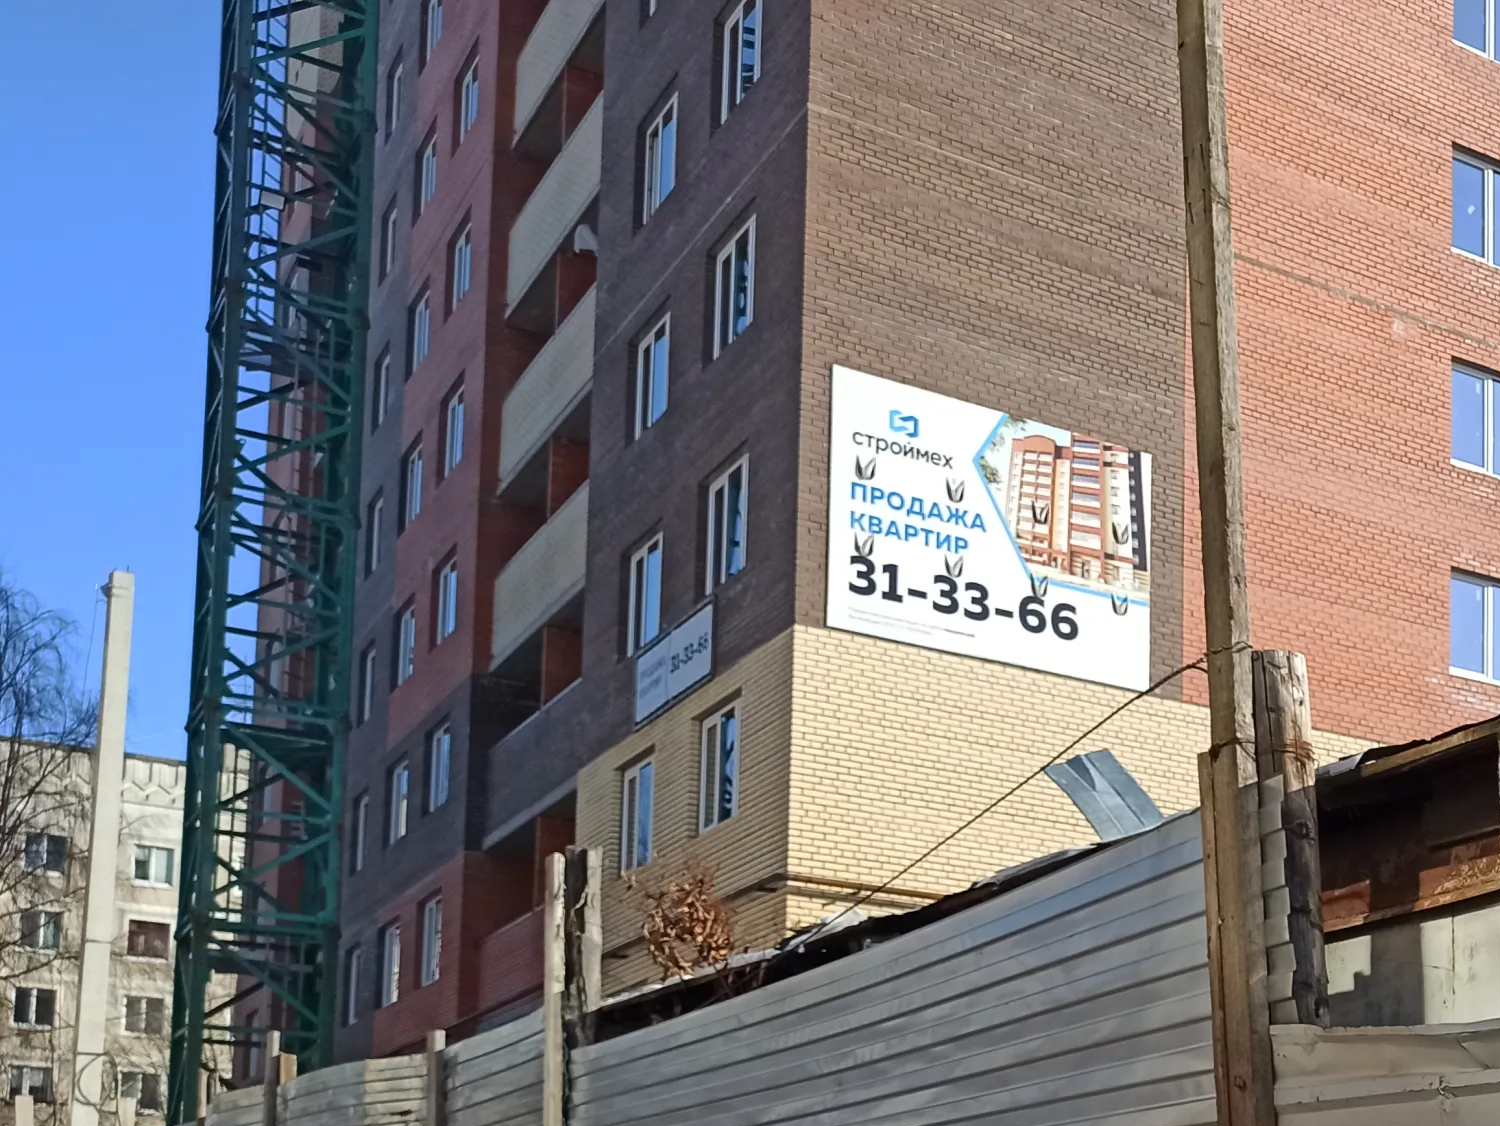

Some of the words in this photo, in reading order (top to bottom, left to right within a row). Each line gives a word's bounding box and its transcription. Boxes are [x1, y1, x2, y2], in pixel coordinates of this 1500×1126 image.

[852, 431, 953, 470] строймех
[850, 481, 987, 533] ПРОДАЖА
[849, 510, 969, 554] КВАРТИР
[849, 555, 1079, 641] 31-33-66
